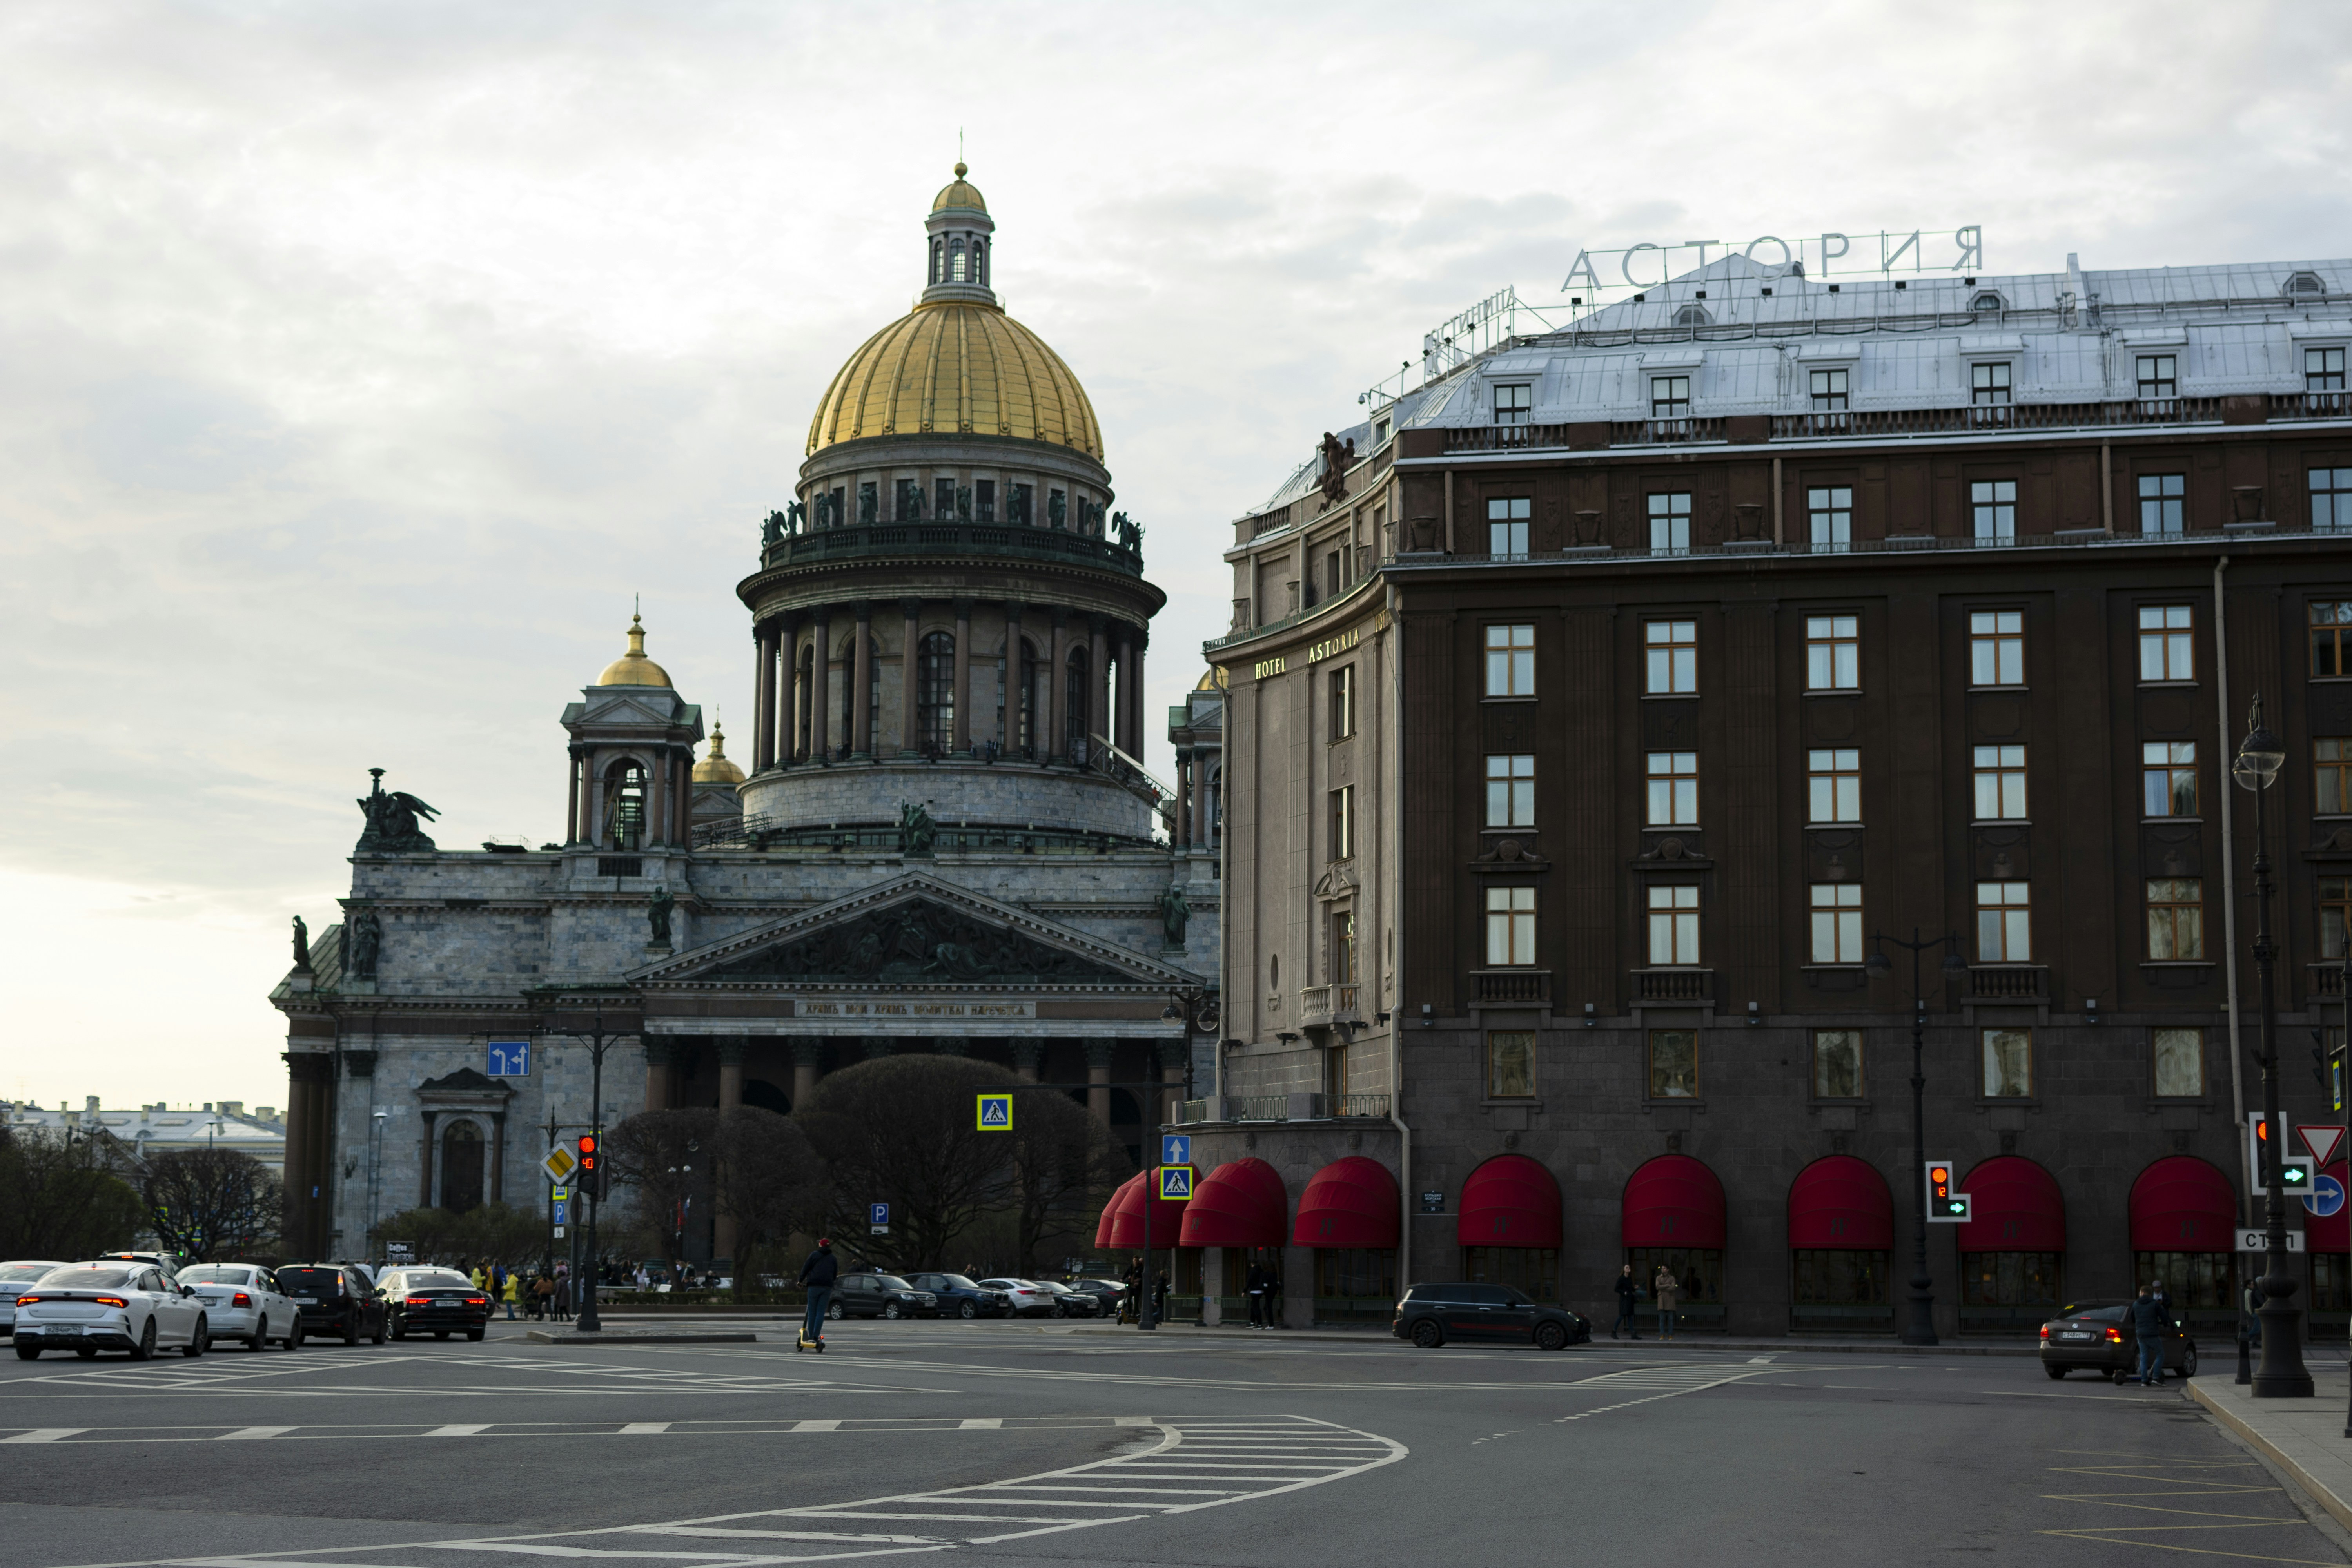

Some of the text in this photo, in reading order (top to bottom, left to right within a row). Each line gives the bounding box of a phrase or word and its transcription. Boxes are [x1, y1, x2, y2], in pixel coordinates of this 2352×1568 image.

[1561, 225, 1982, 292] АСТОРИЯ
[1255, 628, 1359, 680] HOTEL ASTORIA
[582, 1158, 593, 1169] 40
[1938, 1187, 1946, 1197] 12
[557, 1205, 563, 1221] P
[876, 1206, 885, 1221] P
[389, 1243, 407, 1252] Coffee
[2246, 1234, 2294, 1248] СТП
